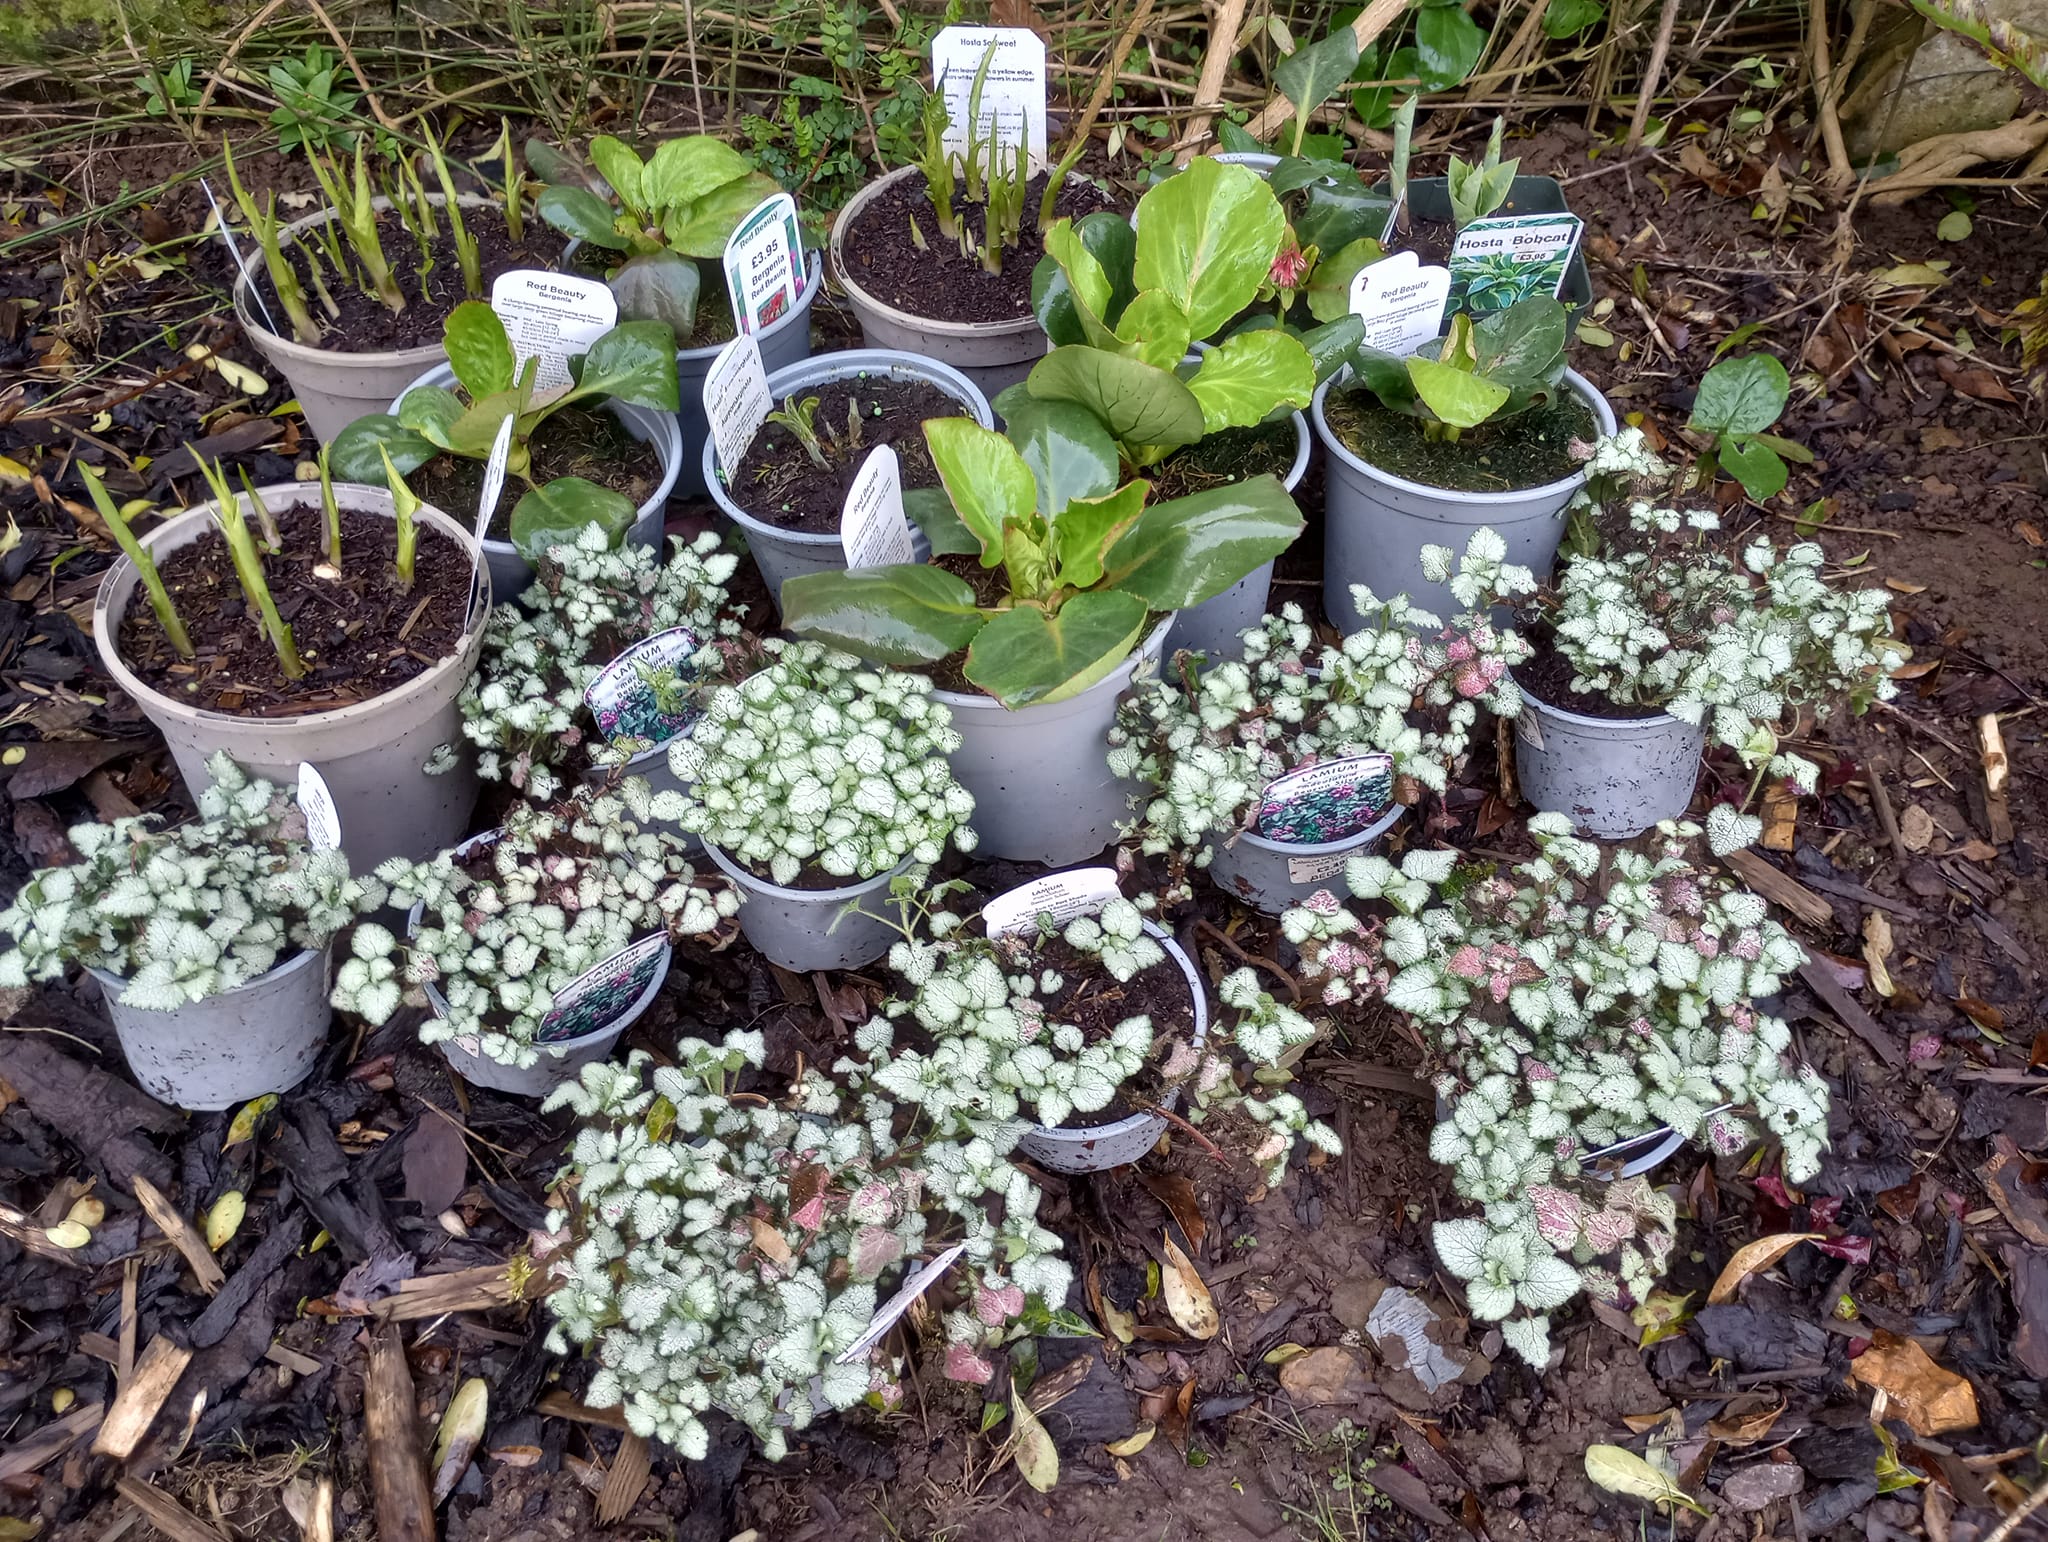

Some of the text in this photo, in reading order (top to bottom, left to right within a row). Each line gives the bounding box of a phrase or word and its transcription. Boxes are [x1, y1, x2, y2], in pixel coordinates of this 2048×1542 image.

[960, 38, 981, 46] Hosta
[740, 211, 779, 250] Red Beauty
[1460, 233, 1567, 249] Hosta Bobcat
[751, 239, 779, 269] £3.95
[752, 253, 785, 286] Bergenia
[526, 281, 586, 300] Red Beauty
[751, 266, 787, 300] Red Beauty
[1381, 280, 1429, 299] Red Beauty
[539, 292, 572, 303] Bergenia
[1302, 763, 1359, 783] LAMIUM
